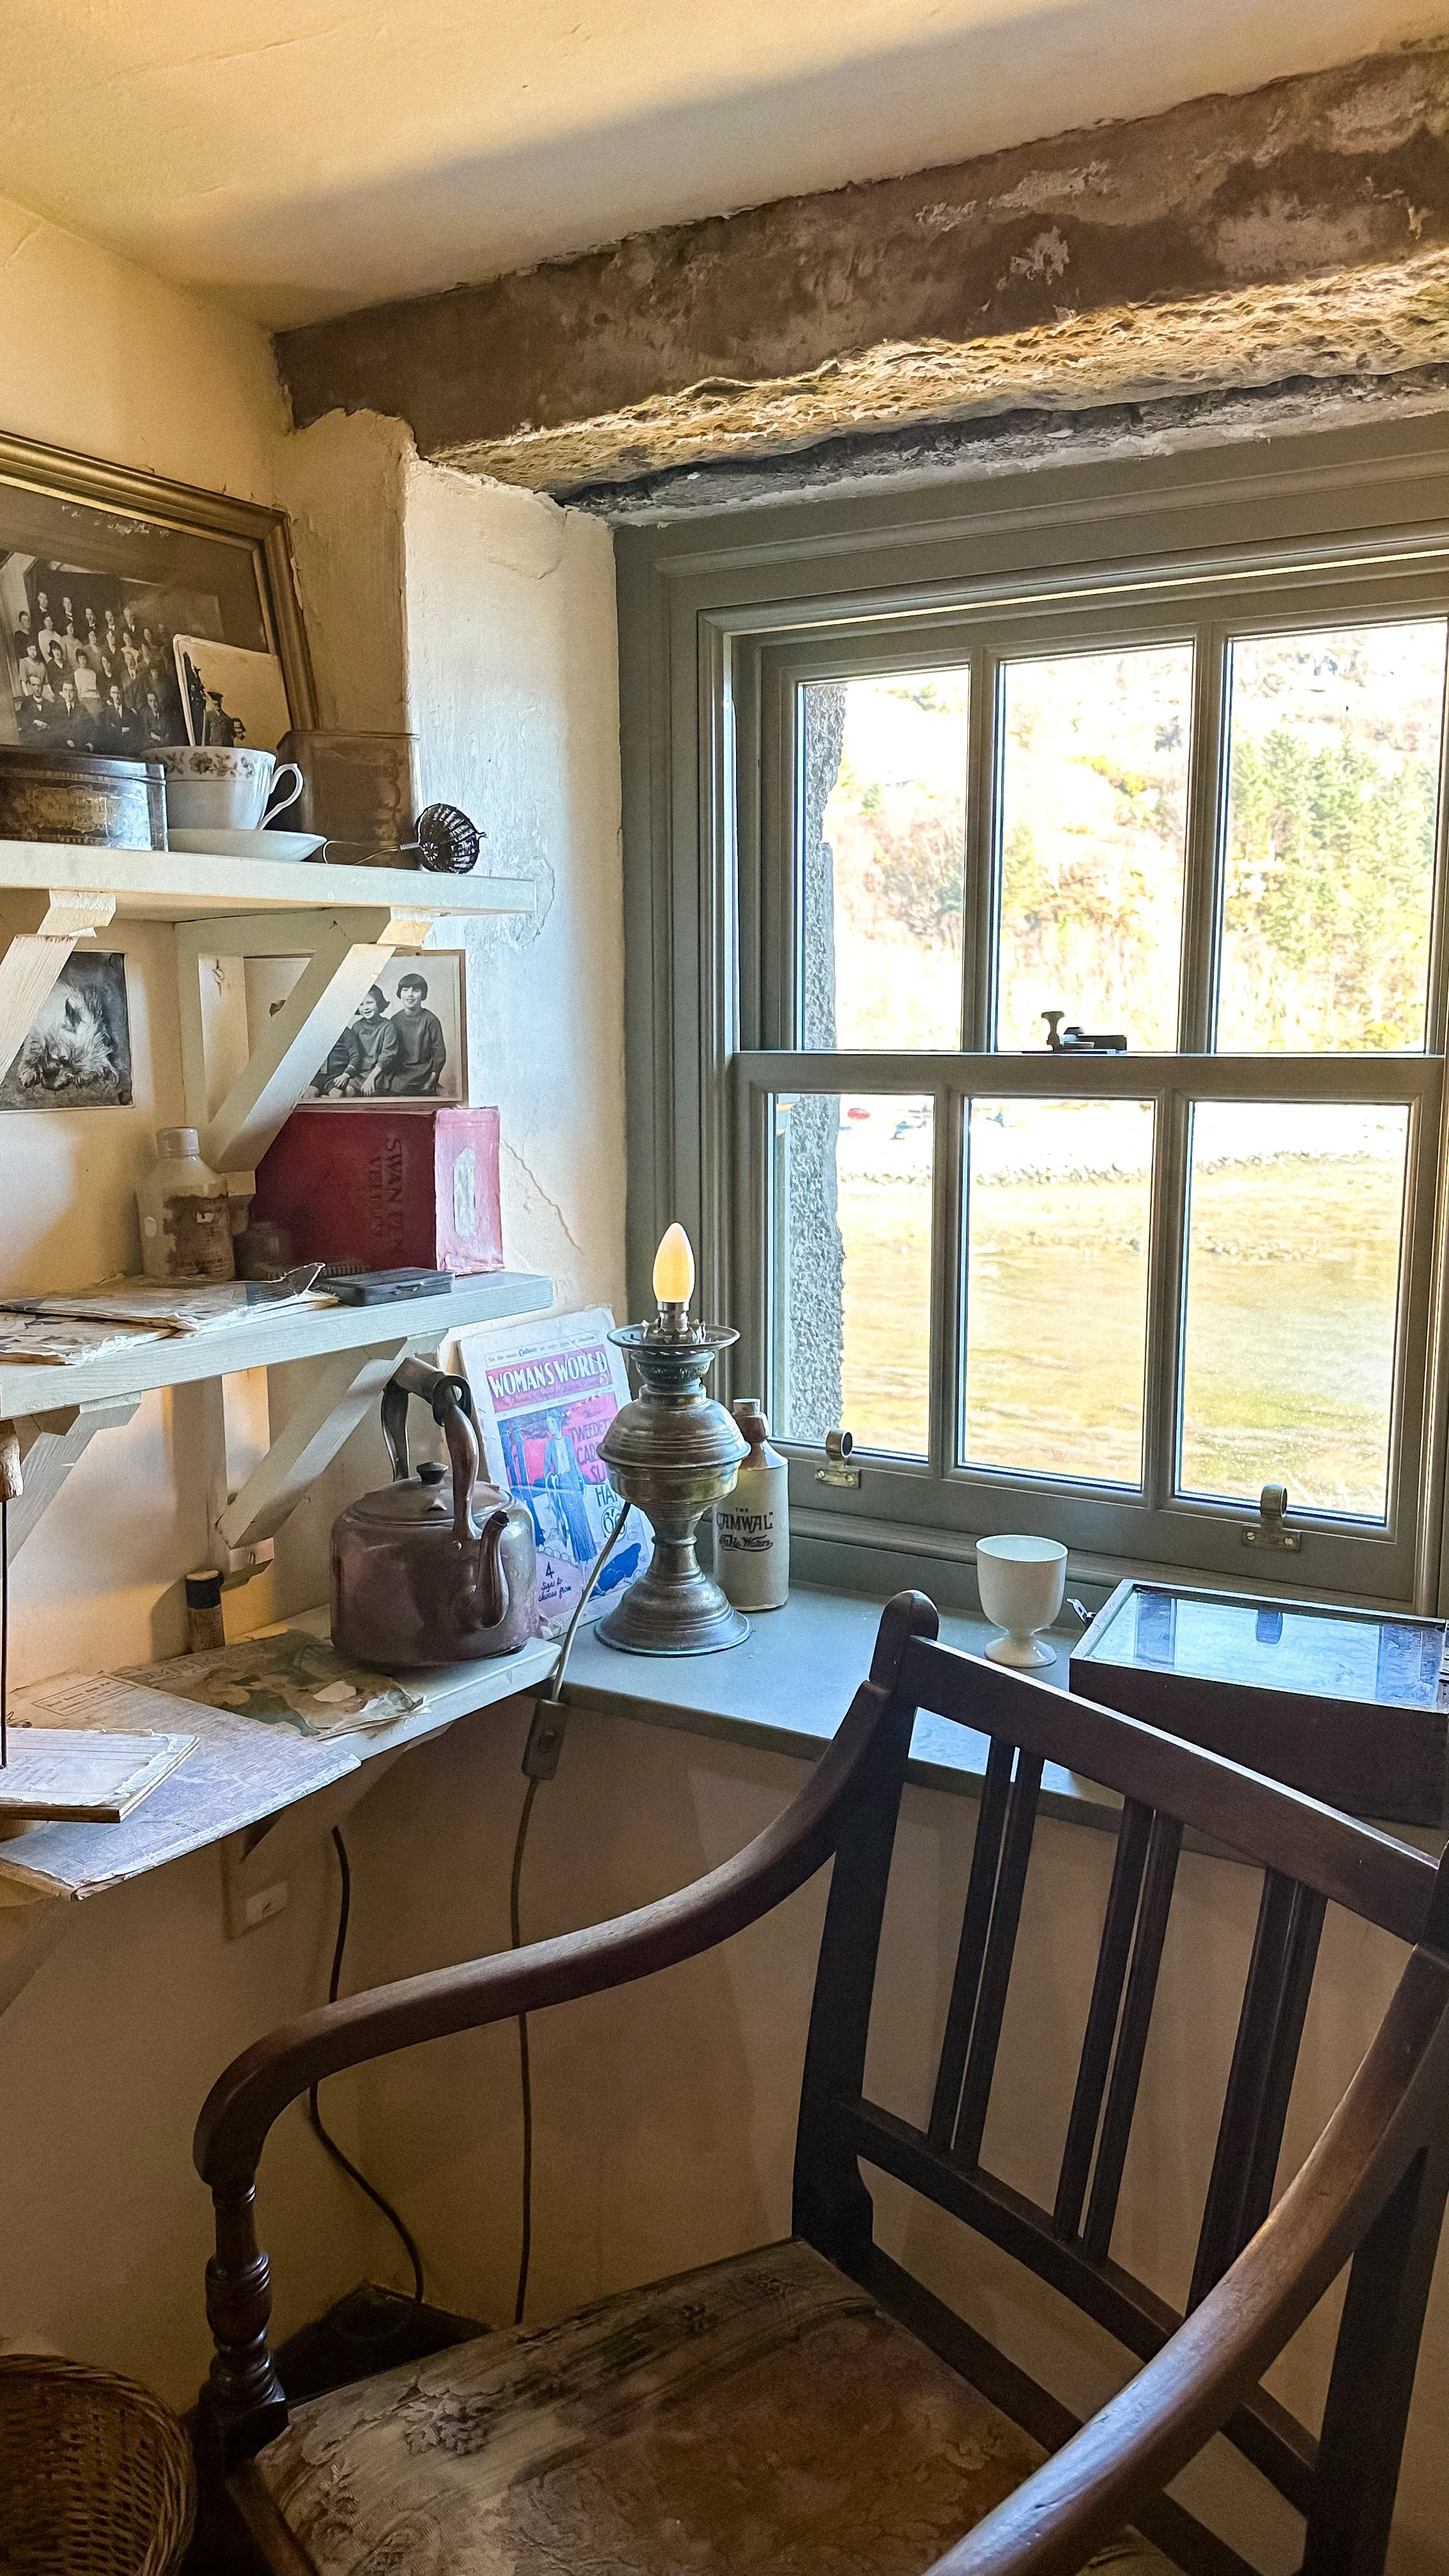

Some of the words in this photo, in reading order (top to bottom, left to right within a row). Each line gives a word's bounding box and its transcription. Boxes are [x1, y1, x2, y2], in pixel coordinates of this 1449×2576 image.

[385, 1138, 403, 1202] SWAN
[553, 1351, 608, 1383] WORLD
[569, 1417, 615, 1443] TWEEDET
[595, 1484, 618, 1507] HA
[716, 1512, 774, 1533] CAMWAL
[719, 1534, 741, 1547] Table
[546, 1561, 555, 1579] 4
[557, 1576, 564, 1586] to
[538, 1590, 558, 1602] choose
[558, 1586, 572, 1599] from
